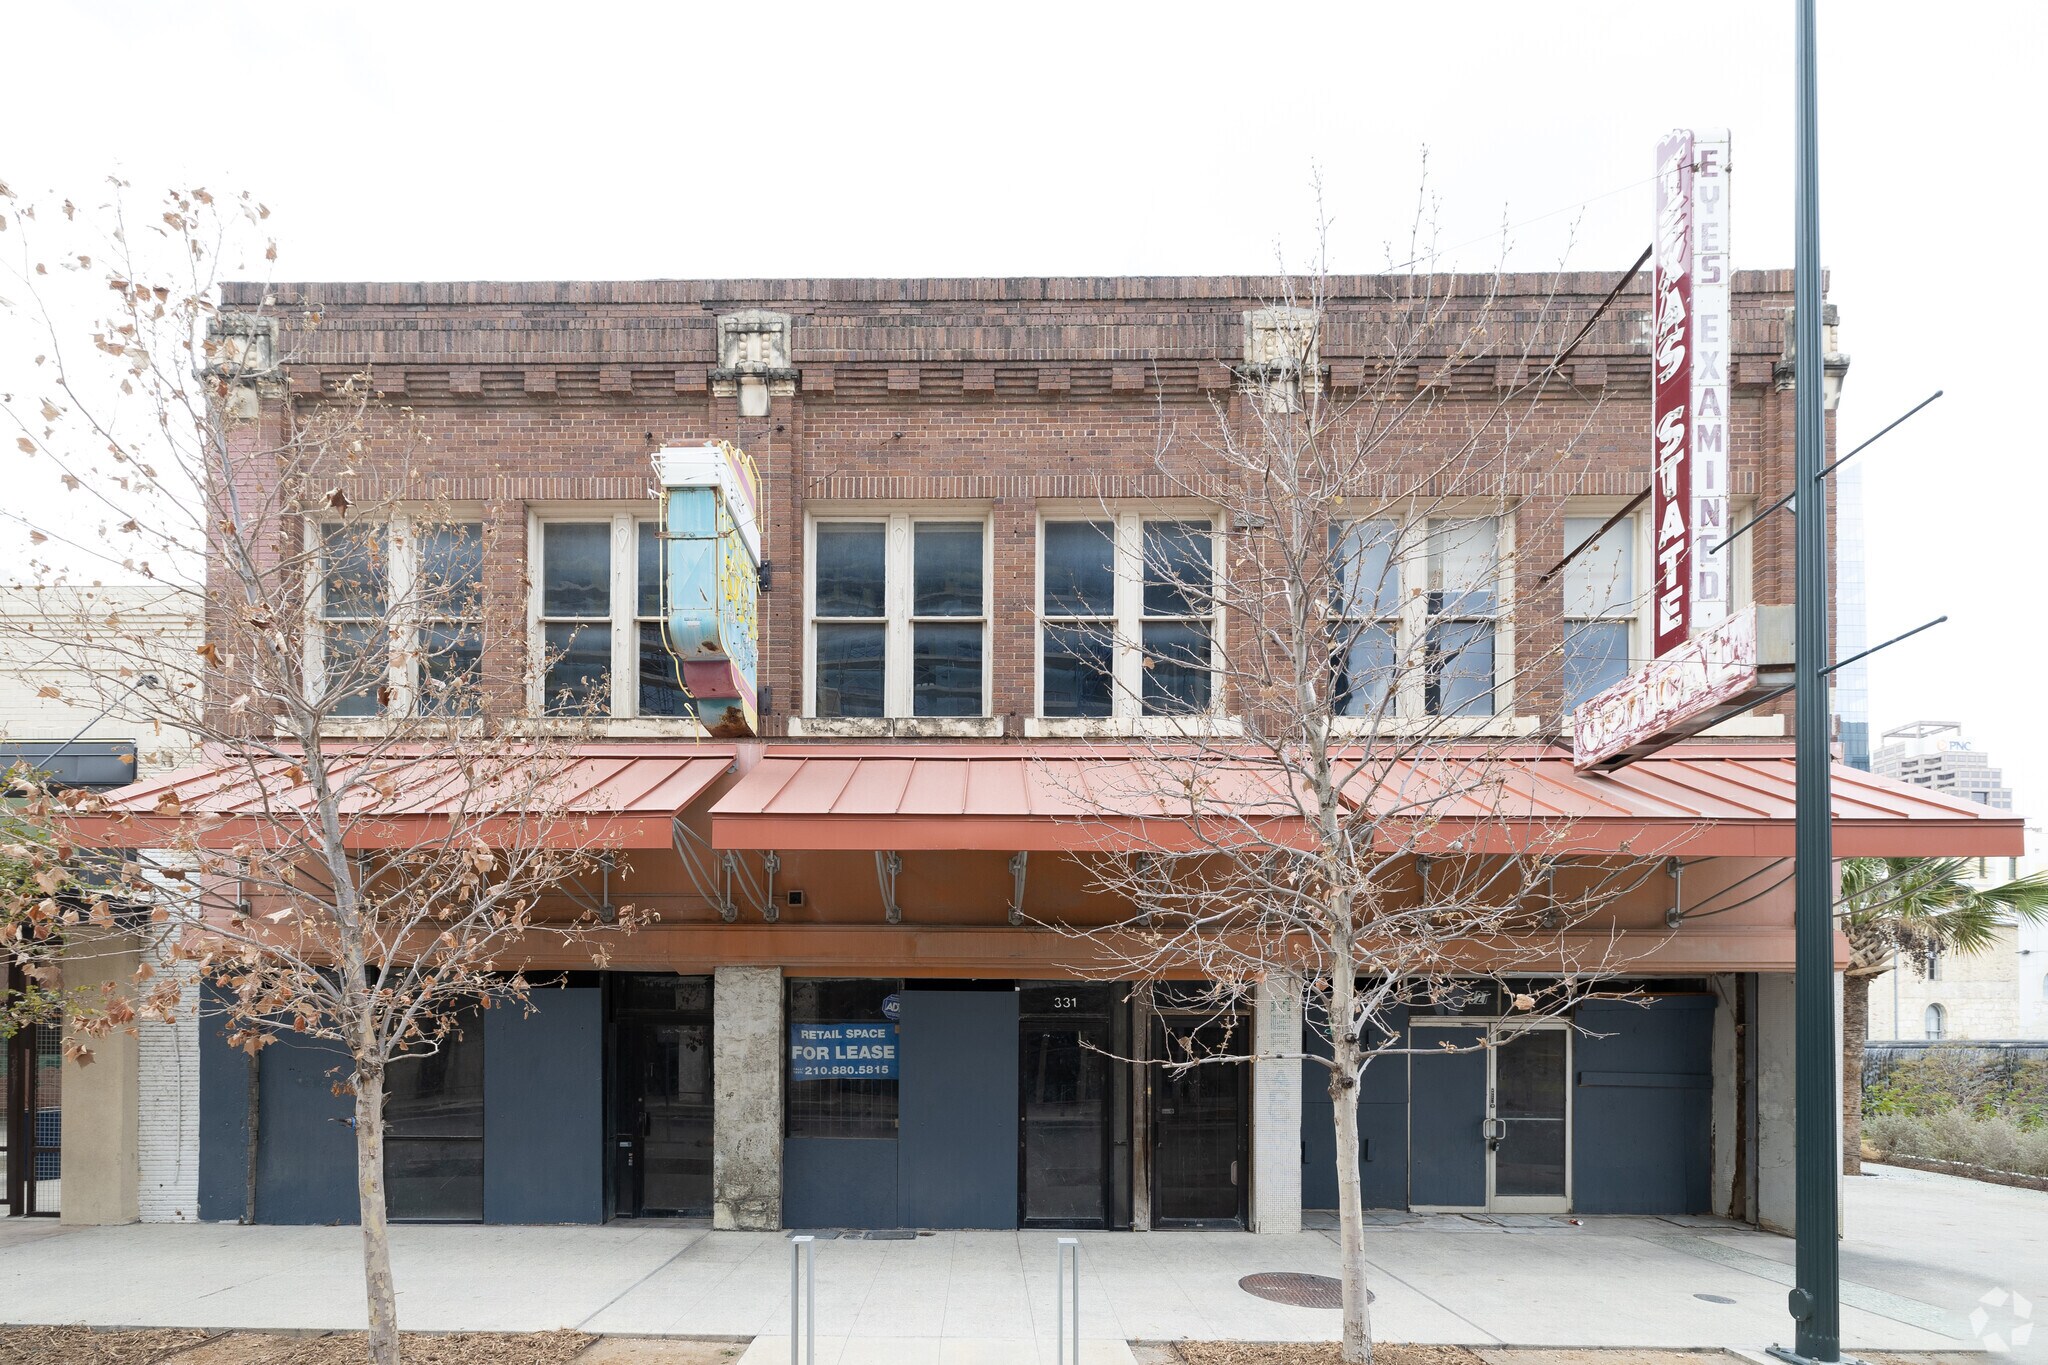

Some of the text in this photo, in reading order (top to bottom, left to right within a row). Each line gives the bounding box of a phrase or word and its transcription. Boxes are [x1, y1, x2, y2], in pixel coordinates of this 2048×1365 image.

[1697, 149, 1723, 600] EYES EXAMINED
[1655, 142, 1688, 636] TEXAS STATE
[1949, 740, 1972, 751] PNC
[1054, 997, 1077, 1008] 331
[801, 1029, 886, 1039] RETAIL SPACE
[792, 1046, 895, 1060] FOR LEASE
[805, 1066, 889, 1075] 210.880.5815
